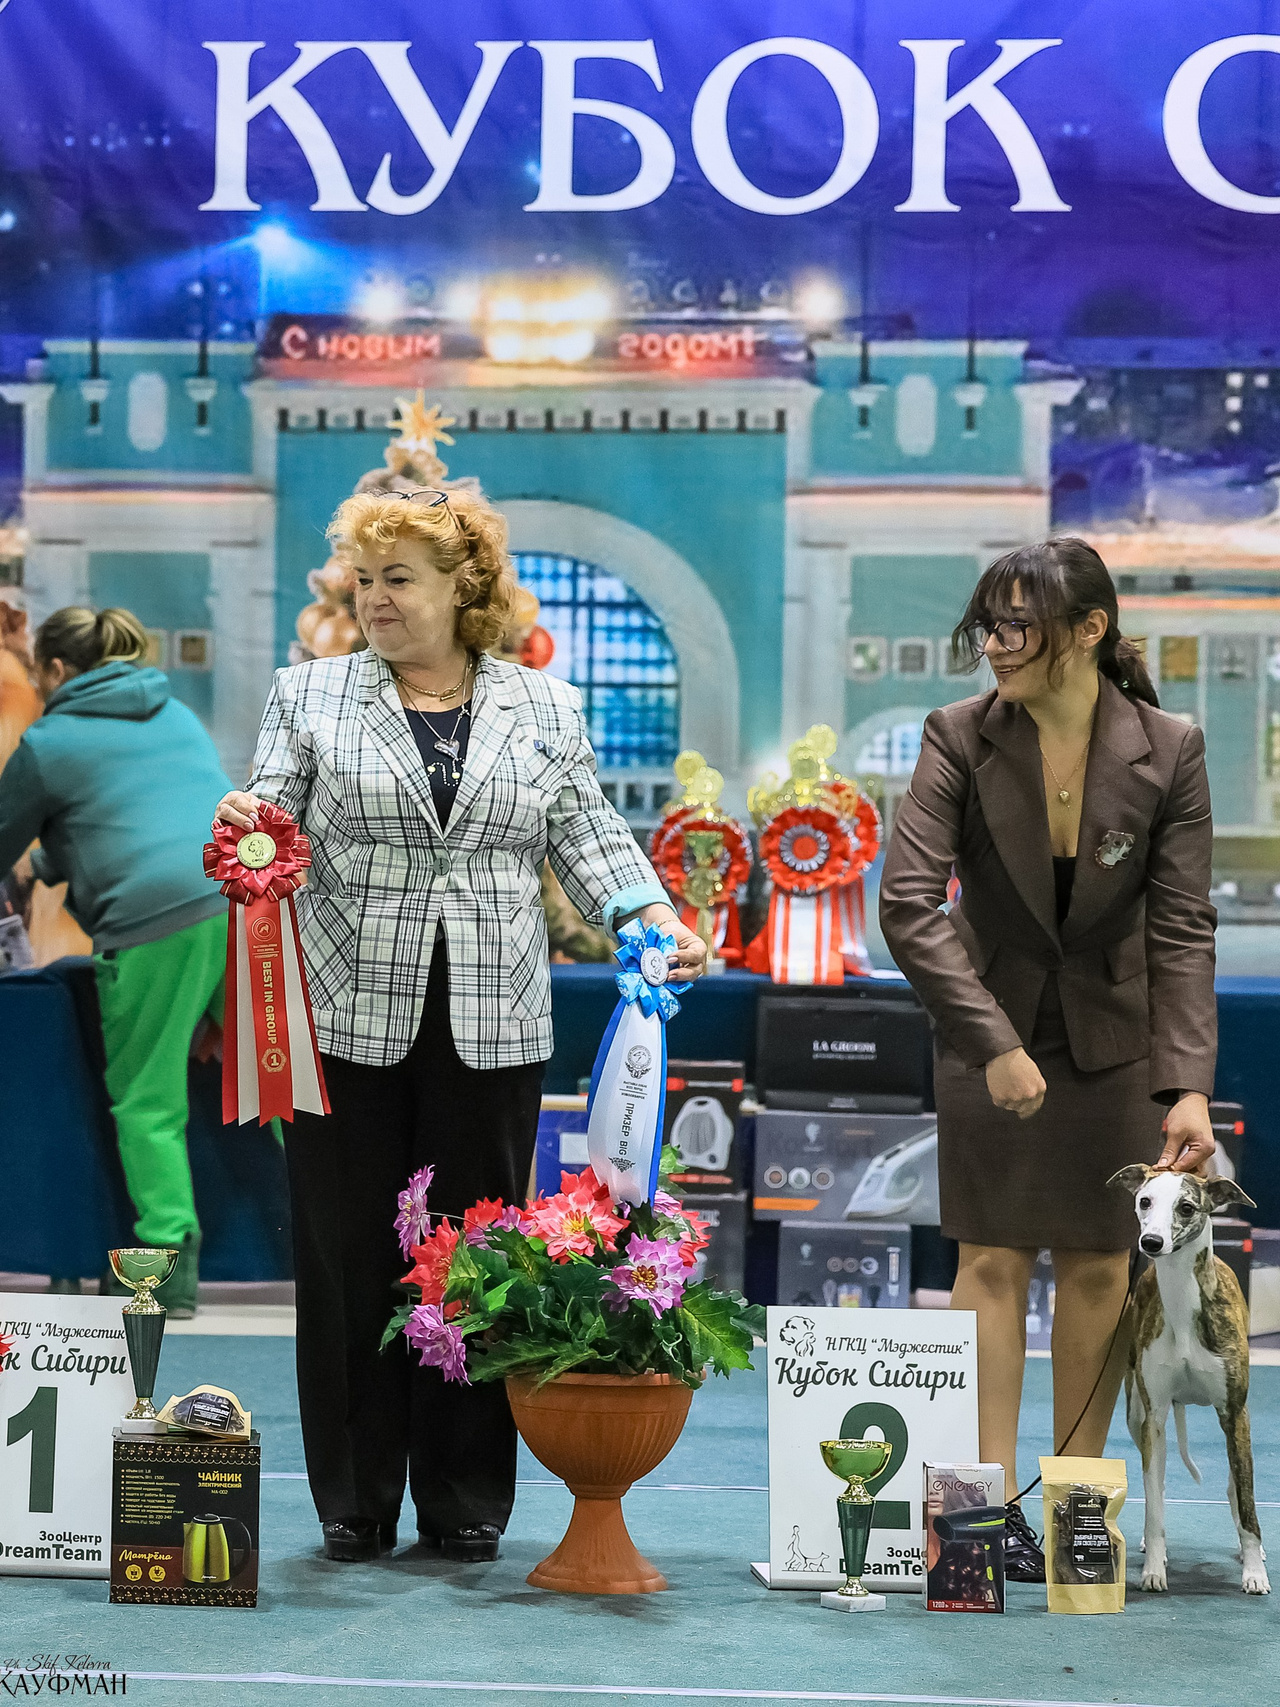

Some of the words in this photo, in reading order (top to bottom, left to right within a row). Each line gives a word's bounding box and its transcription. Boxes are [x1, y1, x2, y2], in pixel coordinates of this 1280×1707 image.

[198, 36, 1072, 215] КУБОК
[262, 961, 273, 989] BEST
[264, 990, 274, 1003] IN
[265, 1005, 277, 1045] GROUP
[270, 1053, 280, 1067] 1
[621, 1102, 635, 1137] ПРИЗЁР
[618, 1140, 628, 1156] BIG
[825, 1336, 867, 1355] НГКЦ
[871, 1337, 970, 1359] “Мэджестик”
[31, 1344, 127, 1385] Сибири
[775, 1357, 858, 1398] Кубок
[869, 1360, 967, 1401] Сибири
[7, 1386, 58, 1514] 1
[197, 1470, 242, 1482] ЧАЙНИК
[838, 1401, 911, 1530] 2
[39, 1530, 102, 1545] ЗооЦентр
[118, 1549, 173, 1562] Матрёна
[886, 1546, 921, 1560] ЗооЦ
